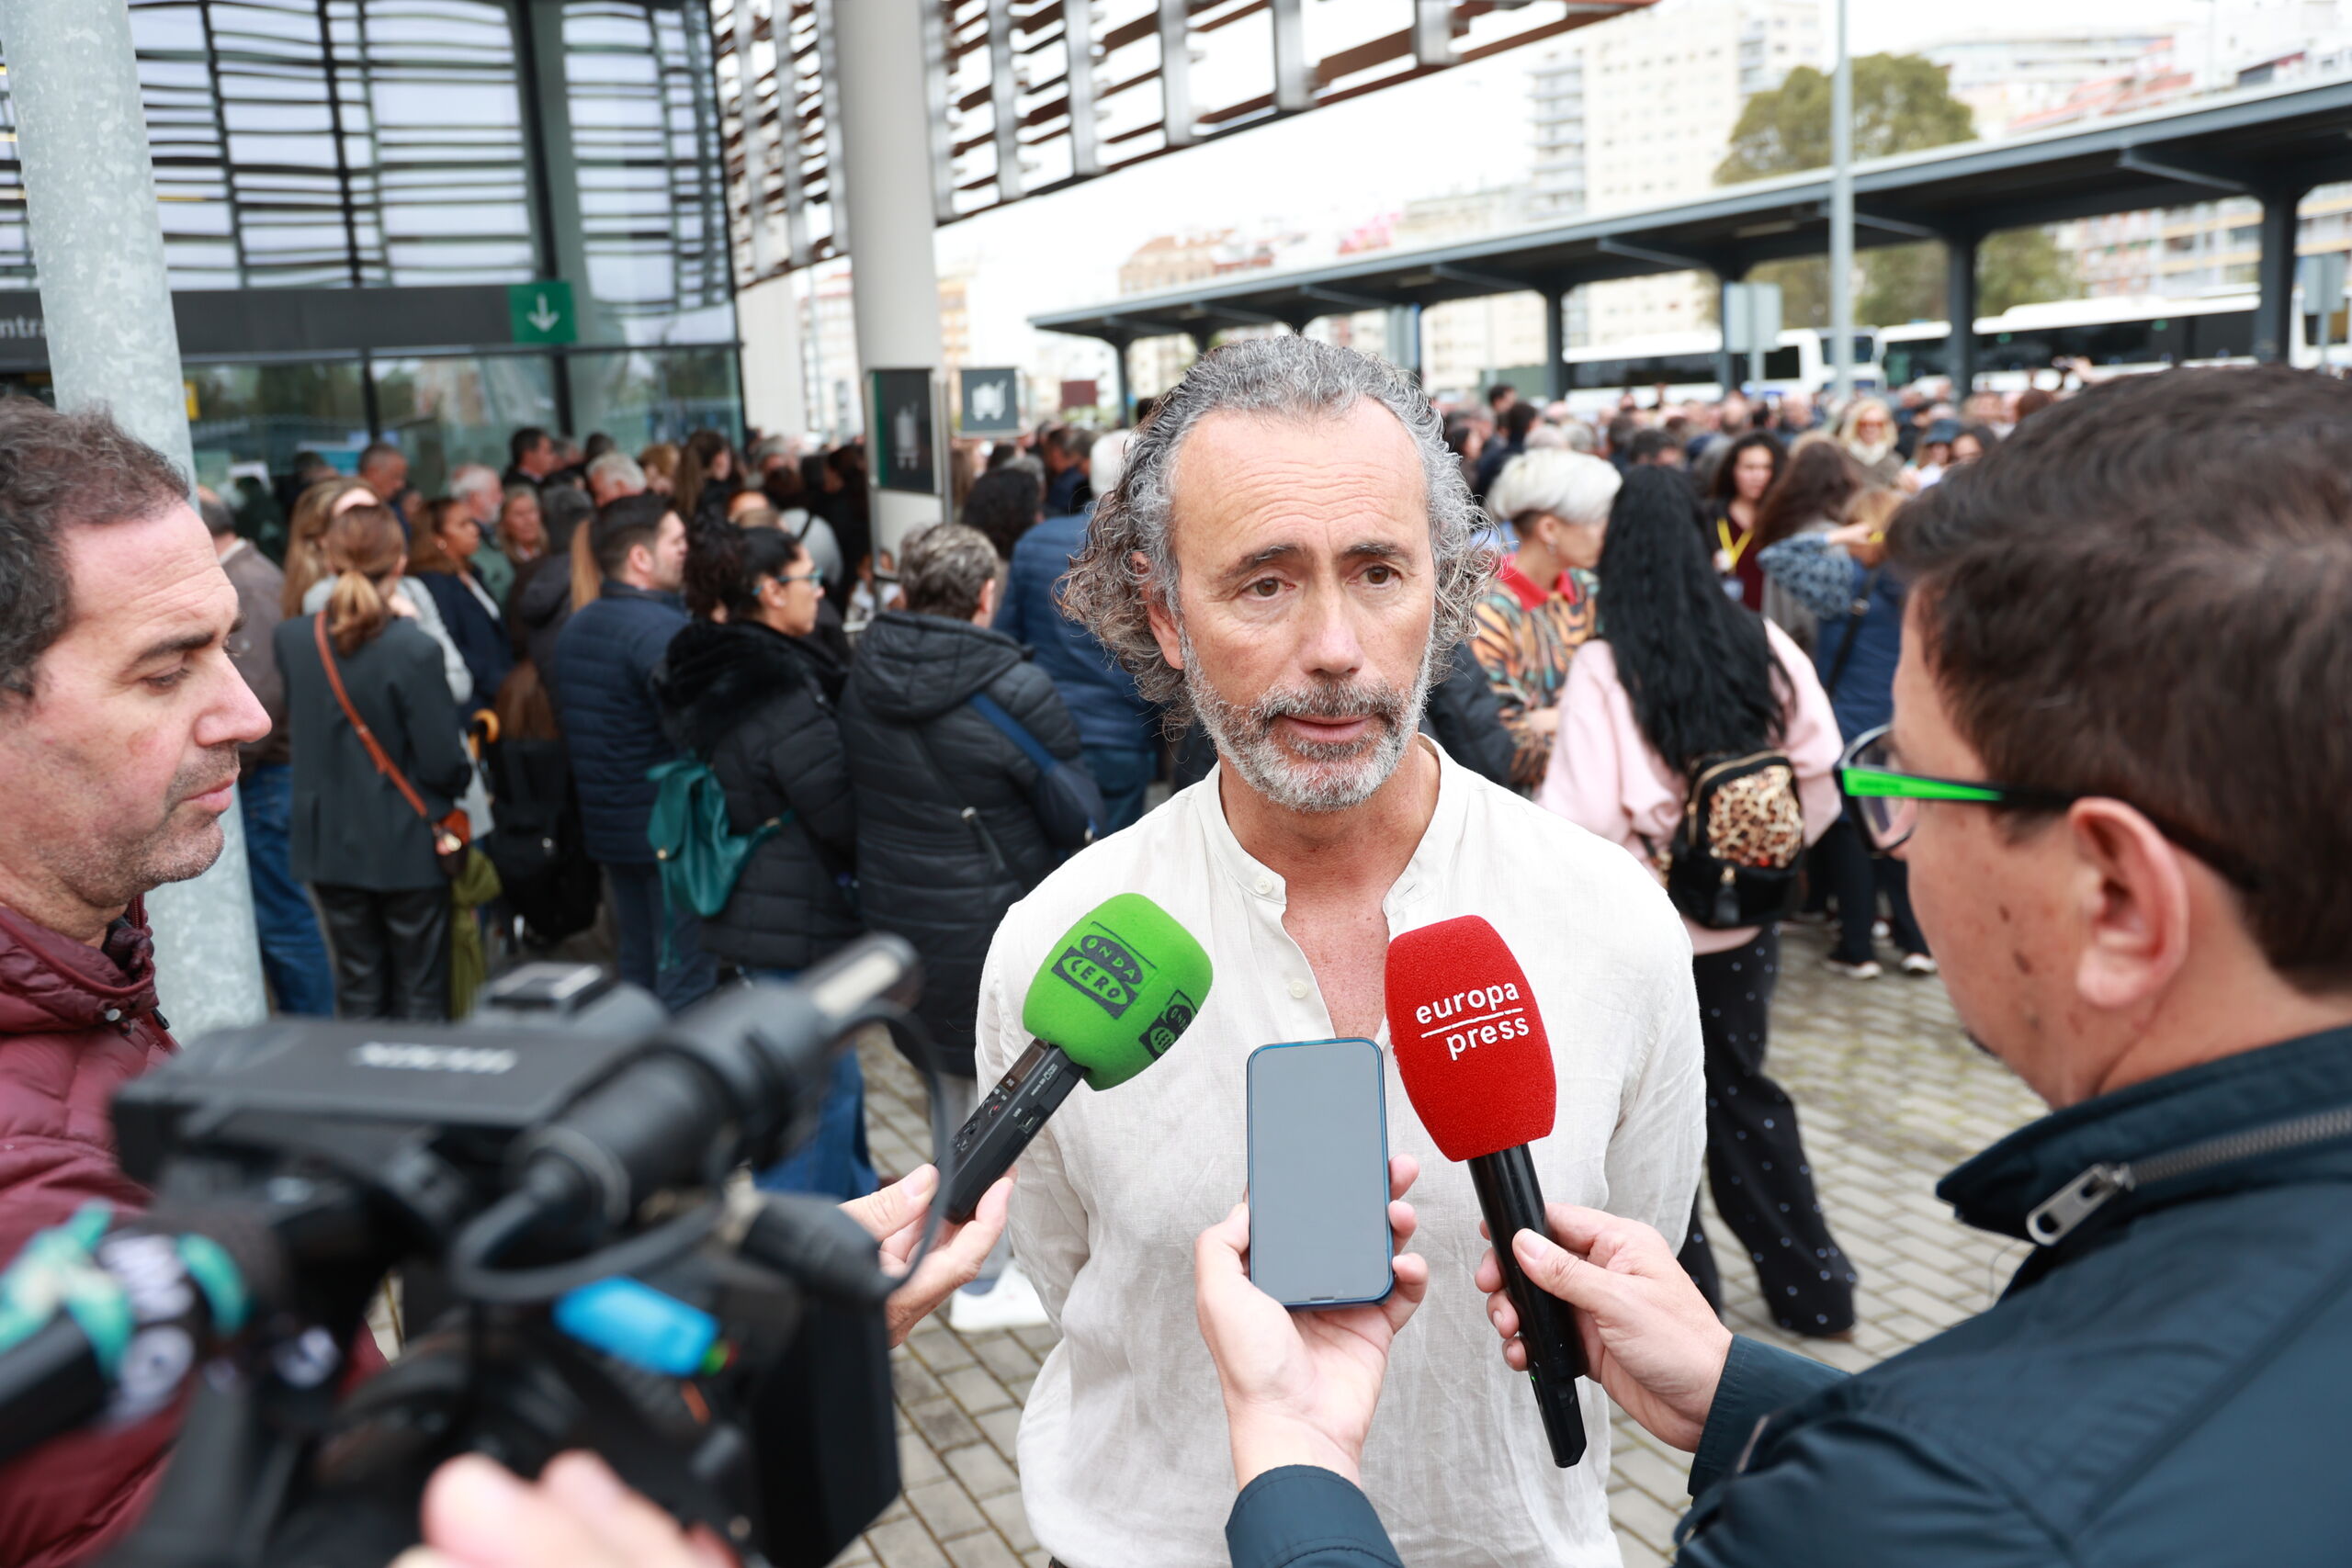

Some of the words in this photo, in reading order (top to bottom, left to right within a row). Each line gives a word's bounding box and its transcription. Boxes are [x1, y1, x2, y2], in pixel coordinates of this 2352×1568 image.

[1070, 959, 1120, 998] CERO
[1086, 937, 1136, 979] ONDA
[1416, 983, 1520, 1024] europa
[1446, 1017, 1530, 1061] press
